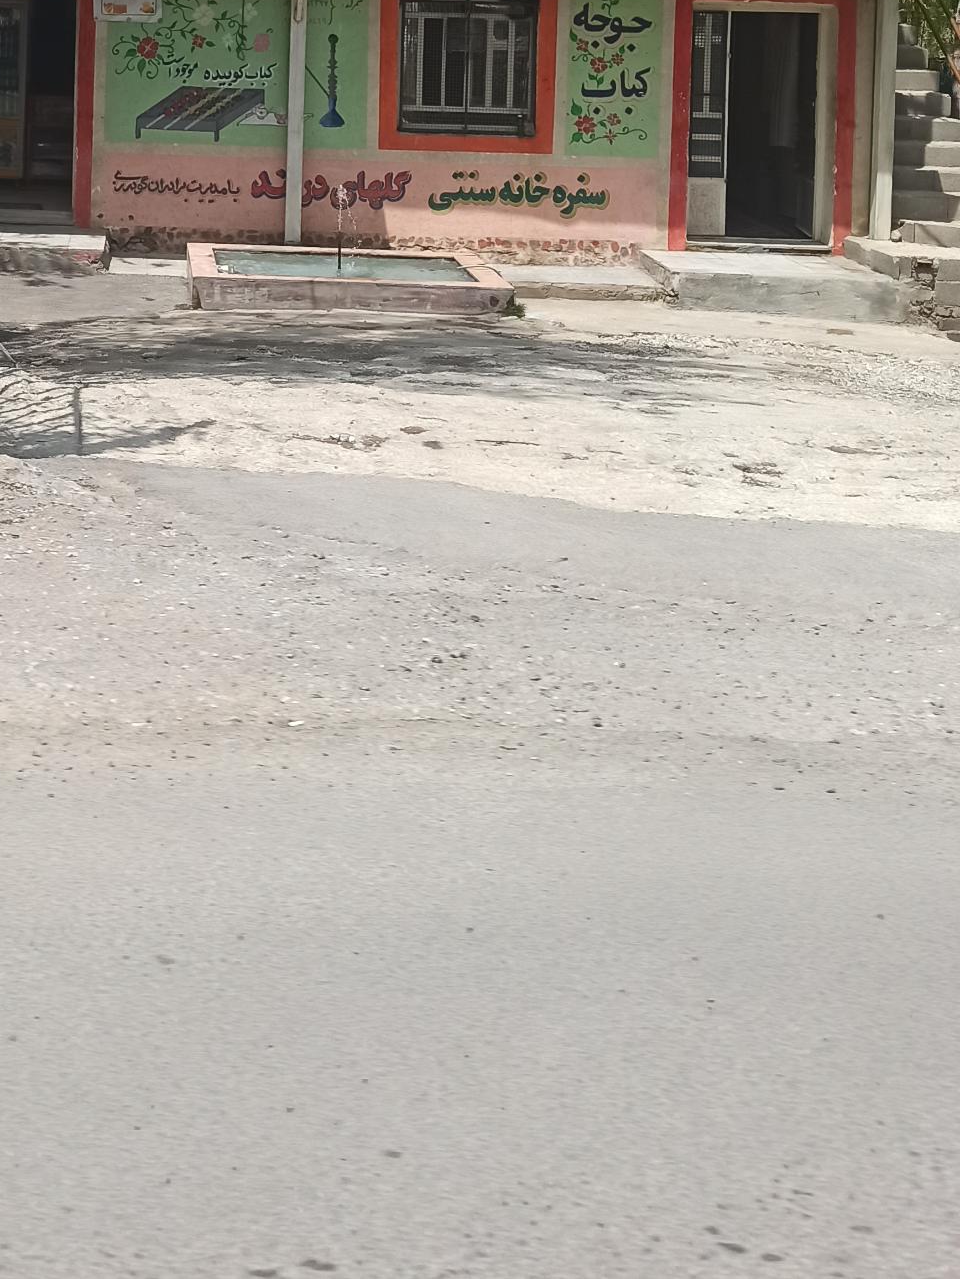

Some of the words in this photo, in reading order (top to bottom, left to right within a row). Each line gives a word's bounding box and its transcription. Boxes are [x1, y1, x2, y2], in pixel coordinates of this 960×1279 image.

[573, 2, 653, 53] جوجه
[174, 62, 199, 84] موجود
[203, 63, 249, 86] کوبیده
[244, 62, 278, 86] کباب
[581, 67, 652, 116] کباب
[251, 168, 330, 208] درند
[428, 170, 498, 214] سنتی
[498, 172, 552, 206] خانه
[552, 174, 610, 219] سفره
